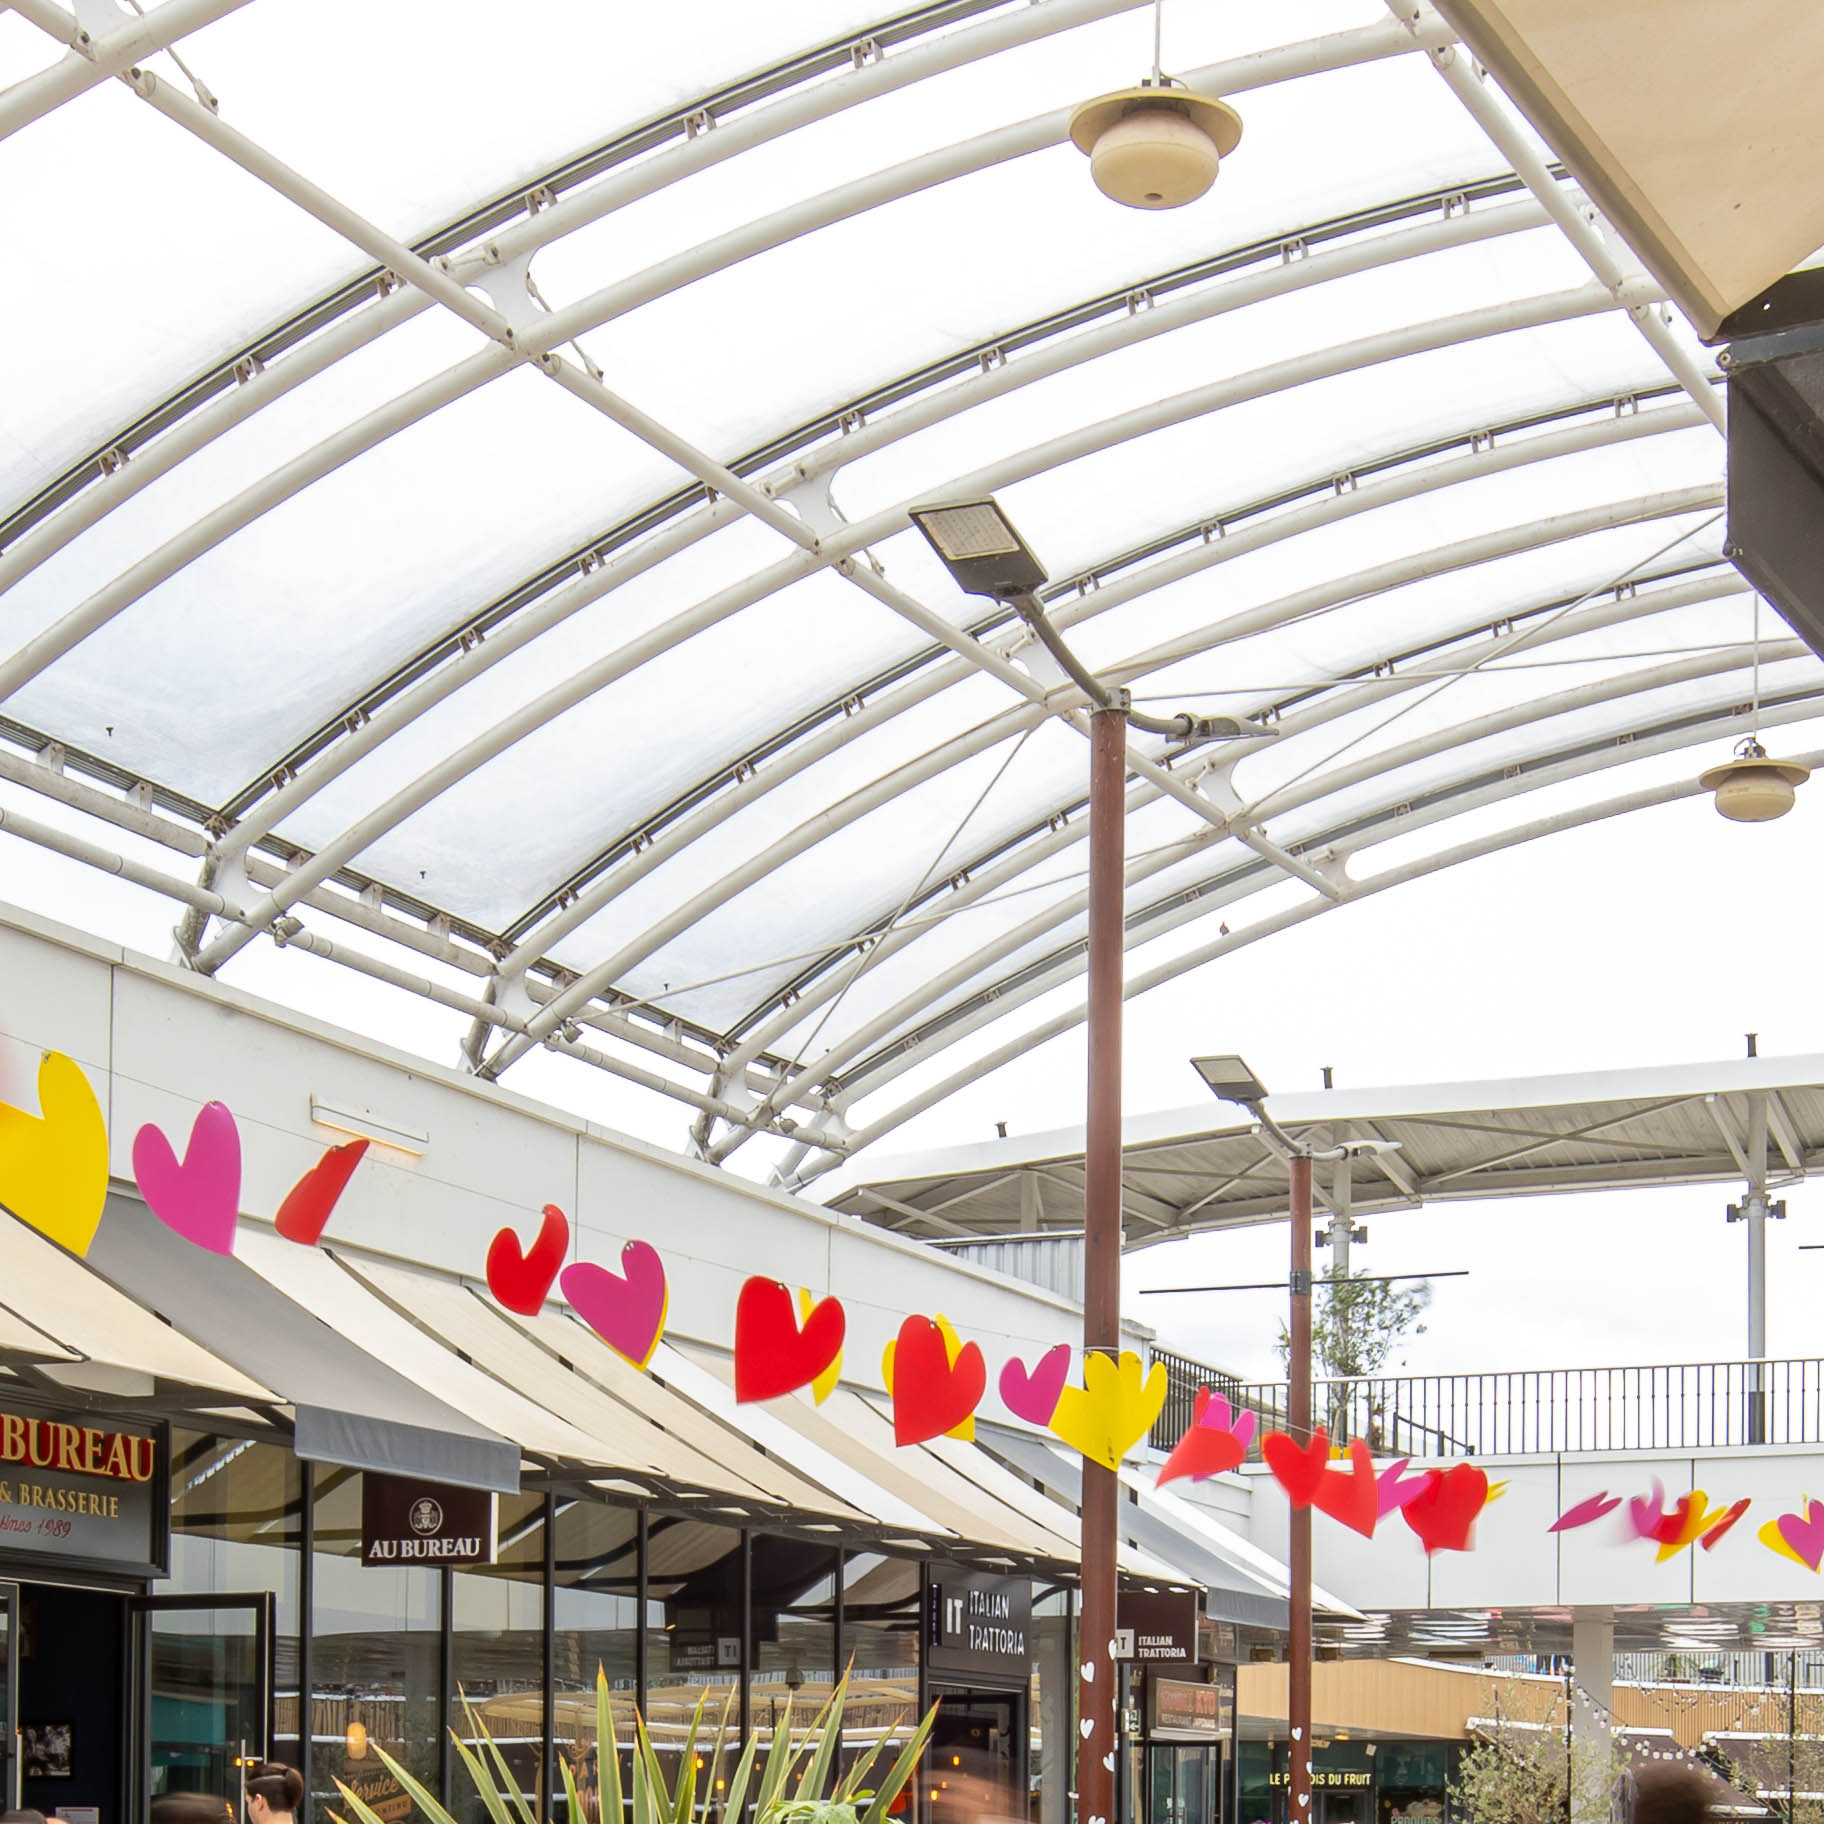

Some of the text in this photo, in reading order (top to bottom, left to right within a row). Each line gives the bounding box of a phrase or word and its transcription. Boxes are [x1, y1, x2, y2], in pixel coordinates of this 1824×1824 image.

[0, 1412, 156, 1482] BUREAU
[19, 1483, 120, 1518] BRASSERIE
[36, 1519, 72, 1538] 1989
[368, 1537, 482, 1559] AU BUREAU
[947, 1598, 964, 1634] IT
[969, 1590, 1010, 1619] ITALIAN
[969, 1624, 1025, 1656] TRATTORIA
[1138, 1635, 1173, 1646] ITALIAN
[1138, 1647, 1186, 1658] TRATTORIA
[1269, 1773, 1281, 1785] LE
[1328, 1773, 1342, 1785] DU
[1344, 1773, 1373, 1785] FRUIT
